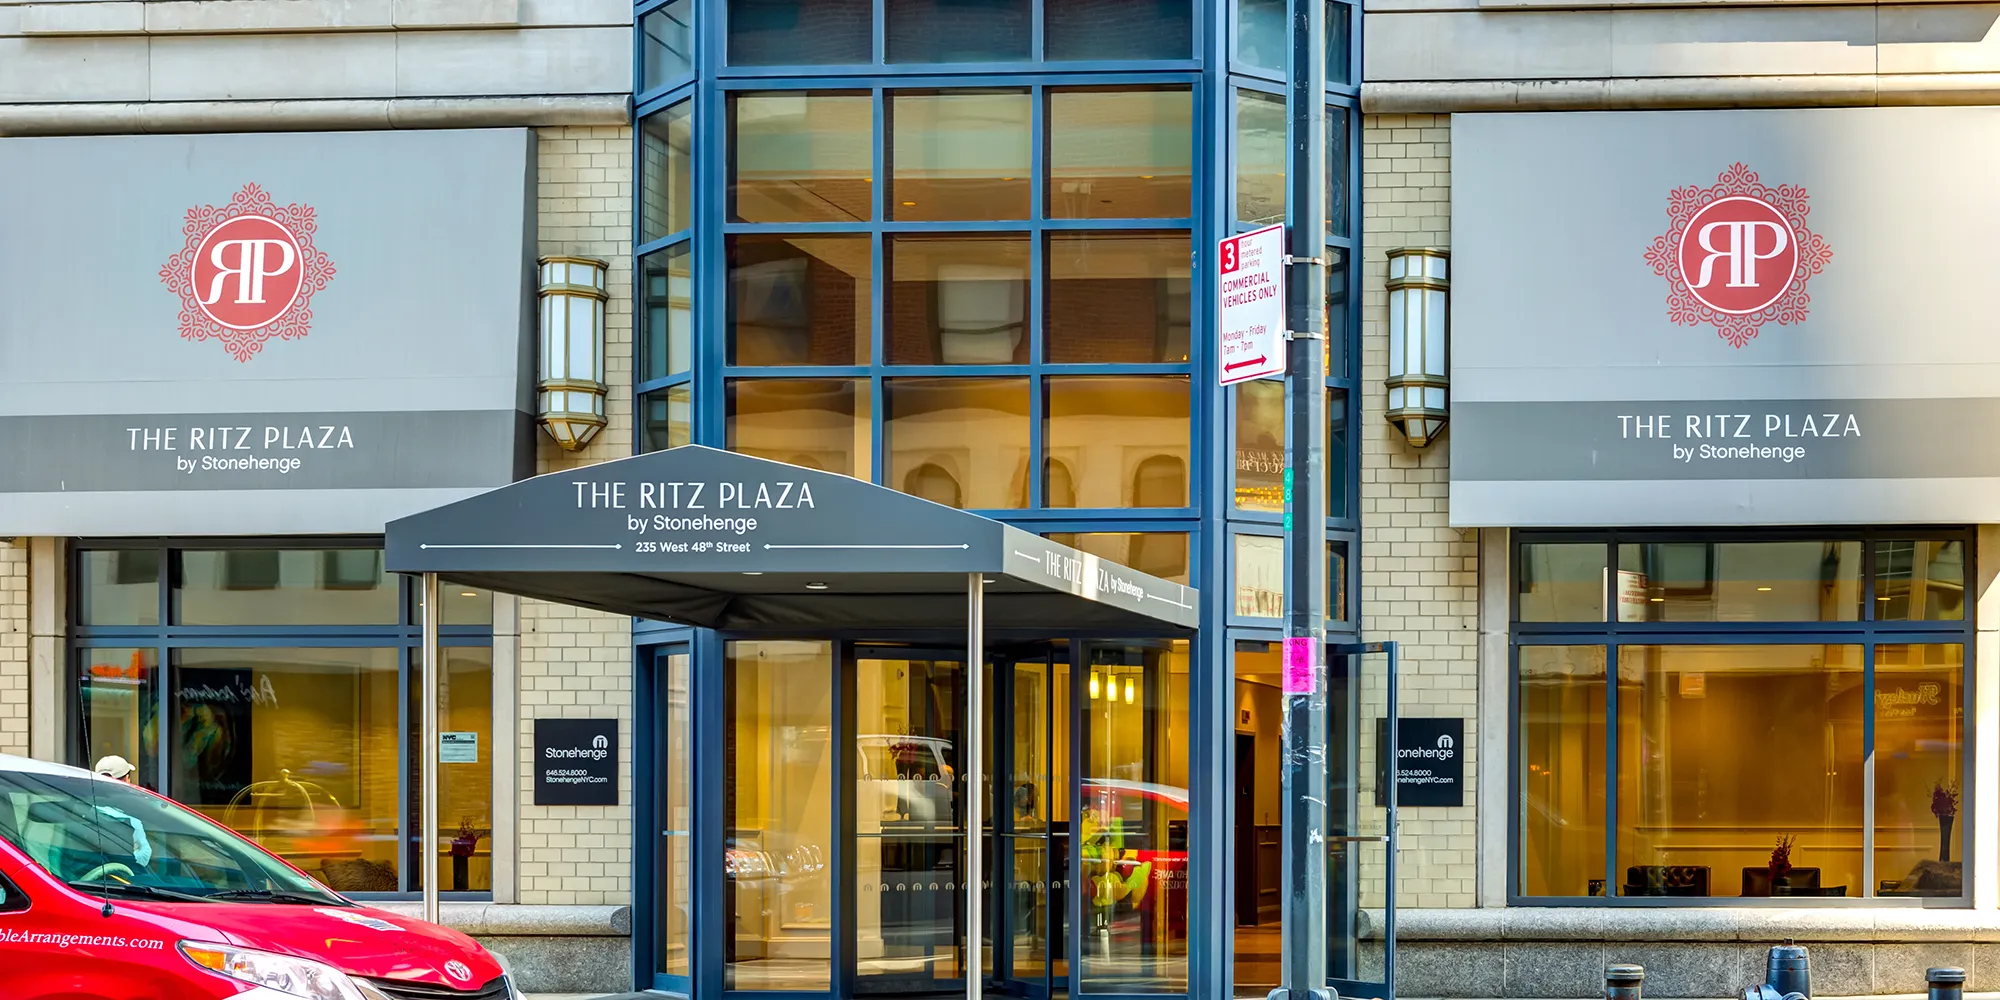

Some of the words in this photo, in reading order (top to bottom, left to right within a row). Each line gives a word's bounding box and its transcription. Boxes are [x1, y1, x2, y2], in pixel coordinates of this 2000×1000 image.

[1240, 239, 1253, 248] hour
[1240, 246, 1263, 258] metered
[1224, 242, 1236, 270] 3
[1240, 258, 1261, 271] parking
[1223, 271, 1270, 294] COMMERCIAL
[1223, 290, 1257, 309] VEHICLES
[1258, 284, 1278, 300] ONLY
[1223, 328, 1245, 342] Monday
[1249, 324, 1267, 336] Friday
[1223, 345, 1236, 355] 7am
[1241, 341, 1254, 353] 7pm
[1617, 415, 1671, 439] THE
[1686, 414, 1752, 438] RITZ
[1765, 413, 1861, 438] PLAZA
[126, 427, 177, 451] THE
[190, 427, 252, 450] RITZ
[264, 426, 354, 449] PLAZA
[1673, 443, 1695, 463] by
[1699, 443, 1806, 463] Stonehenge
[177, 455, 197, 474] by
[201, 455, 301, 474] Stonehenge
[572, 481, 626, 509] THE
[640, 482, 706, 509] RITZ
[719, 482, 815, 509] PLAZA
[627, 514, 649, 535] by
[653, 514, 758, 535] Stonehenge
[635, 541, 657, 553] 235
[659, 541, 689, 553] West
[691, 541, 714, 553] 48th
[716, 541, 751, 553] Street
[1045, 550, 1061, 578] THE
[1063, 556, 1082, 585] RITZ
[1110, 574, 1117, 594] by
[1117, 577, 1144, 602] Stonehenge
[545, 746, 608, 761] Stonehenge
[1397, 746, 1454, 761] onehenge
[545, 776, 608, 785] StonehengeNYC.com
[1396, 776, 1454, 785] nehengeNYC.com
[0, 928, 164, 950] bleArrangements.com
